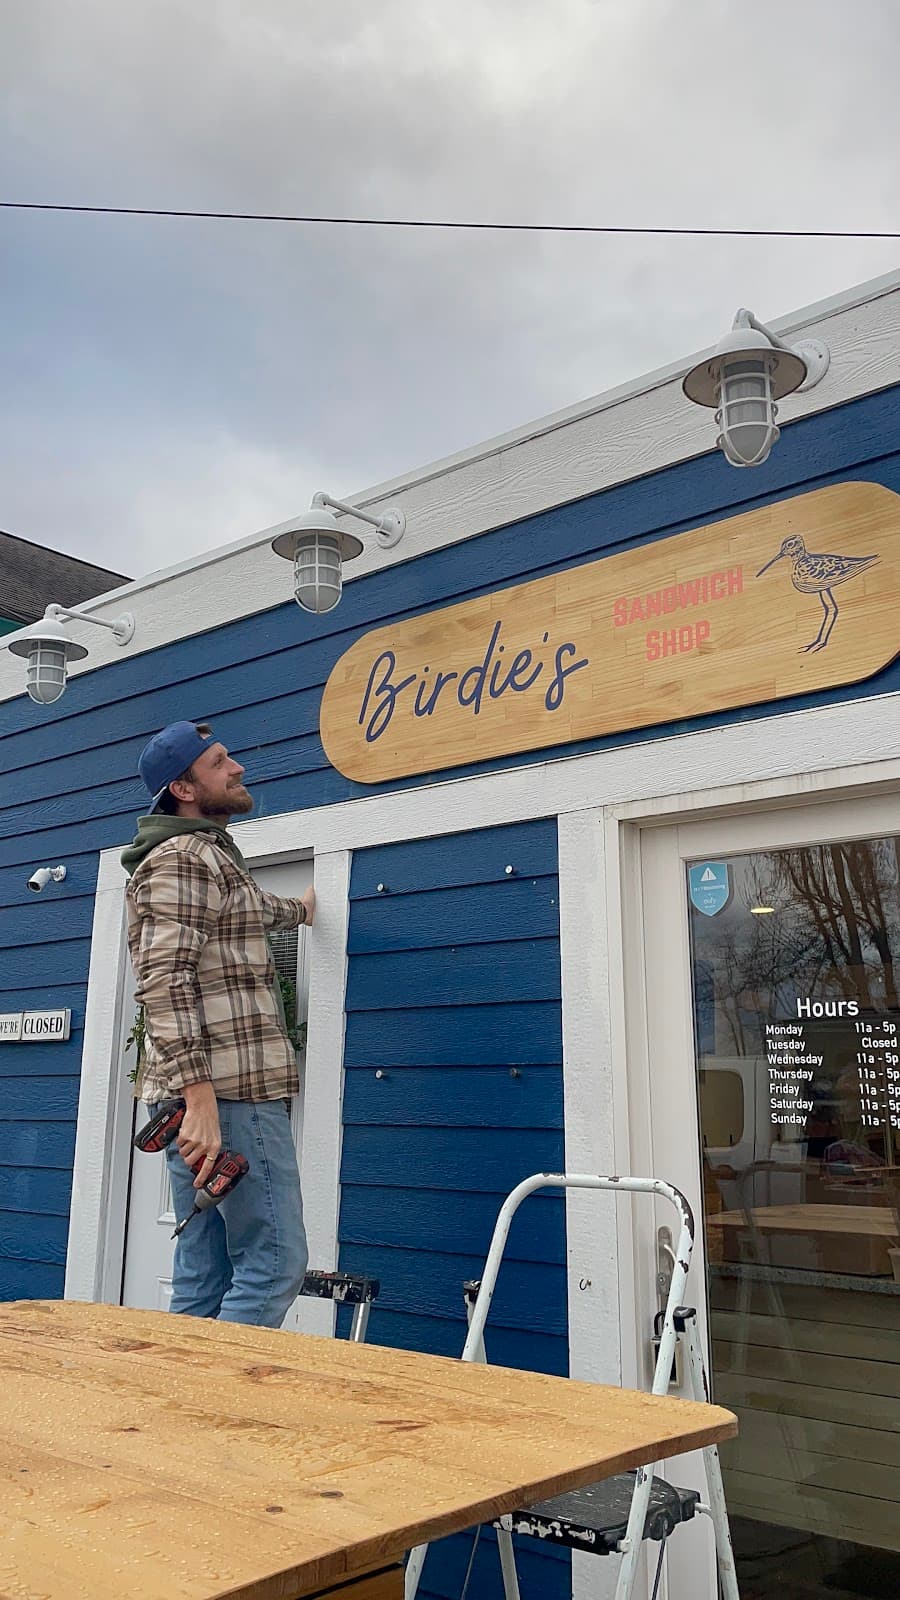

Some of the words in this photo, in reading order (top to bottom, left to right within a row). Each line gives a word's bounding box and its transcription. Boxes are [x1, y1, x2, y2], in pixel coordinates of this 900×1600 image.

[613, 564, 744, 627] SANDWICH
[646, 620, 711, 661] SHOP
[358, 620, 589, 742] Birdie's
[796, 997, 859, 1018] Hours
[24, 1016, 63, 1034] CLOSED
[765, 1024, 803, 1036] Monday
[855, 1022, 872, 1033] 11a
[882, 1021, 896, 1034] 5p
[766, 1039, 806, 1052] Tuesday
[861, 1037, 898, 1048] Closed
[767, 1053, 823, 1066] Wednesday
[856, 1052, 875, 1064] 11a
[885, 1052, 899, 1066] 5p
[768, 1068, 814, 1081] Thursday
[857, 1067, 876, 1079] 11a
[886, 1067, 900, 1082] 5p
[769, 1083, 800, 1096] Friday
[859, 1083, 877, 1096] 11a
[888, 1083, 900, 1098] 5p
[770, 1098, 814, 1112] Saturday
[860, 1099, 879, 1111] 11a
[771, 1113, 807, 1126] Sunday
[861, 1114, 880, 1126] 11a
